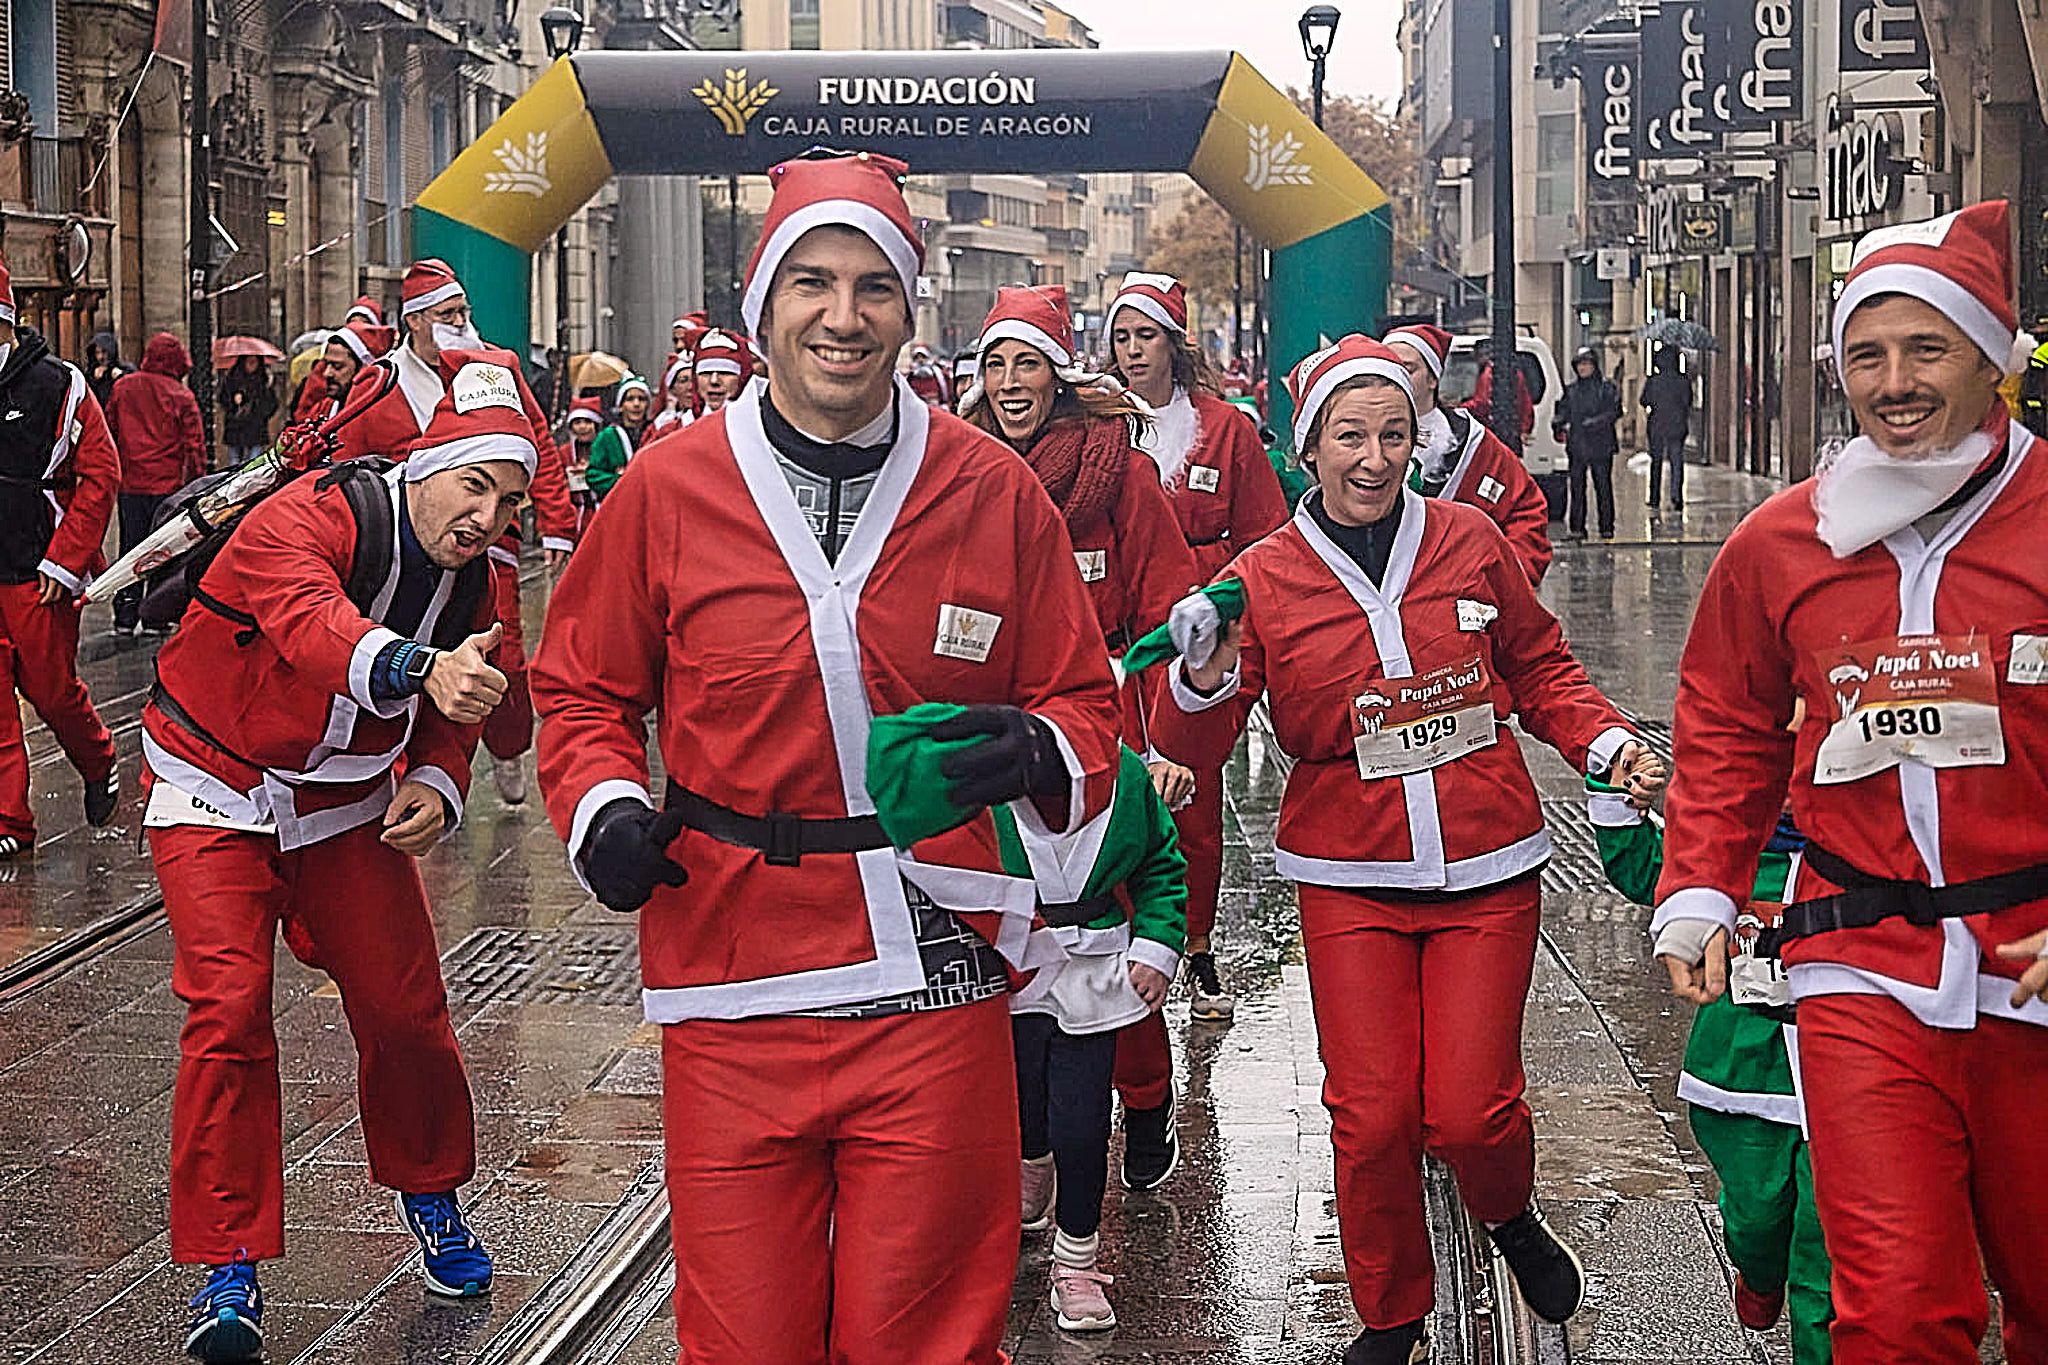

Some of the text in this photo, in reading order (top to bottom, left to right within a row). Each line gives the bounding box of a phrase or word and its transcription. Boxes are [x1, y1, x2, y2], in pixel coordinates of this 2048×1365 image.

[818, 71, 1036, 105] FUNDACIÓN
[763, 113, 1092, 136] CAJA RURAL DE ARAGÓN
[1593, 64, 1631, 178] fnac
[1825, 92, 1889, 218] fnac
[458, 389, 488, 402] CAJA
[490, 386, 519, 401] RURA
[1874, 649, 1981, 676] Papá Noel
[1400, 667, 1480, 703] Papá Noel
[1889, 679, 1917, 691] CAJA
[1397, 715, 1457, 750] 1929
[1858, 706, 1942, 743] 1930
